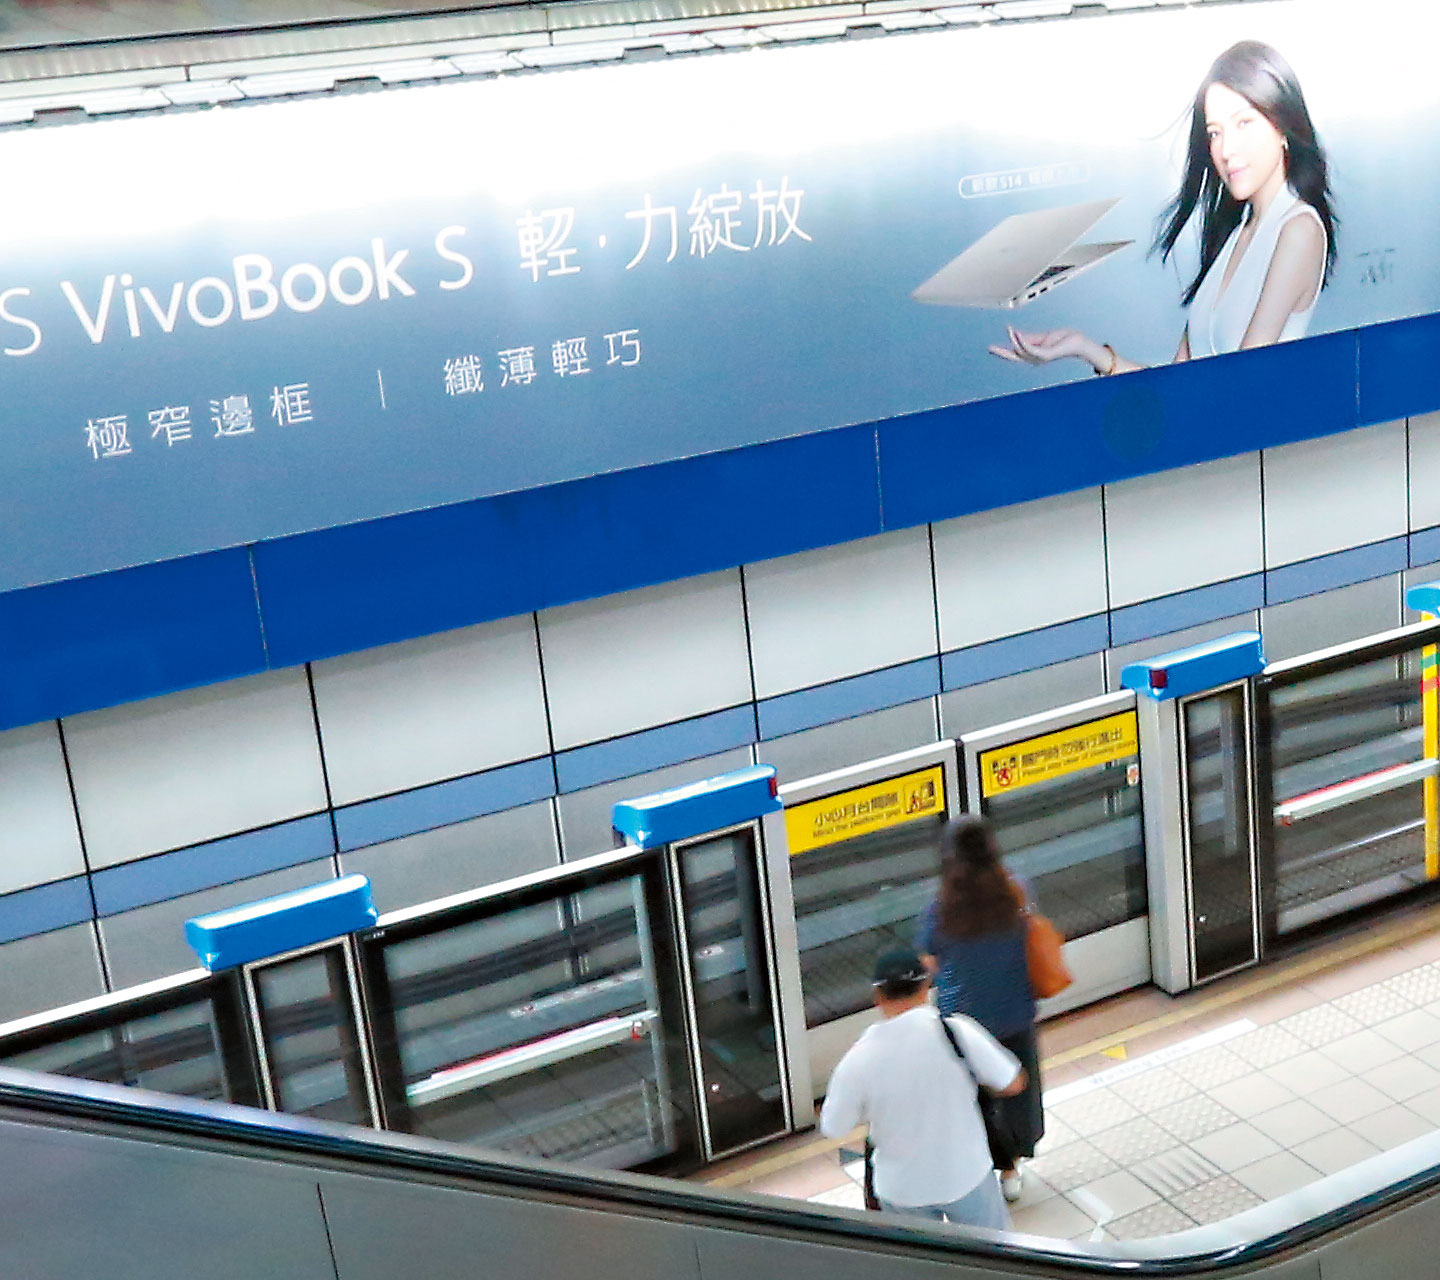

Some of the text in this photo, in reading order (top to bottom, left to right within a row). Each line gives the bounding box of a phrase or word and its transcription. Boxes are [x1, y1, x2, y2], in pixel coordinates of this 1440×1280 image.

[60, 245, 417, 344] VivoBook
[435, 224, 475, 291] S
[442, 328, 643, 397] 纖薄輕巧
[84, 382, 314, 460] 極窄邊框
